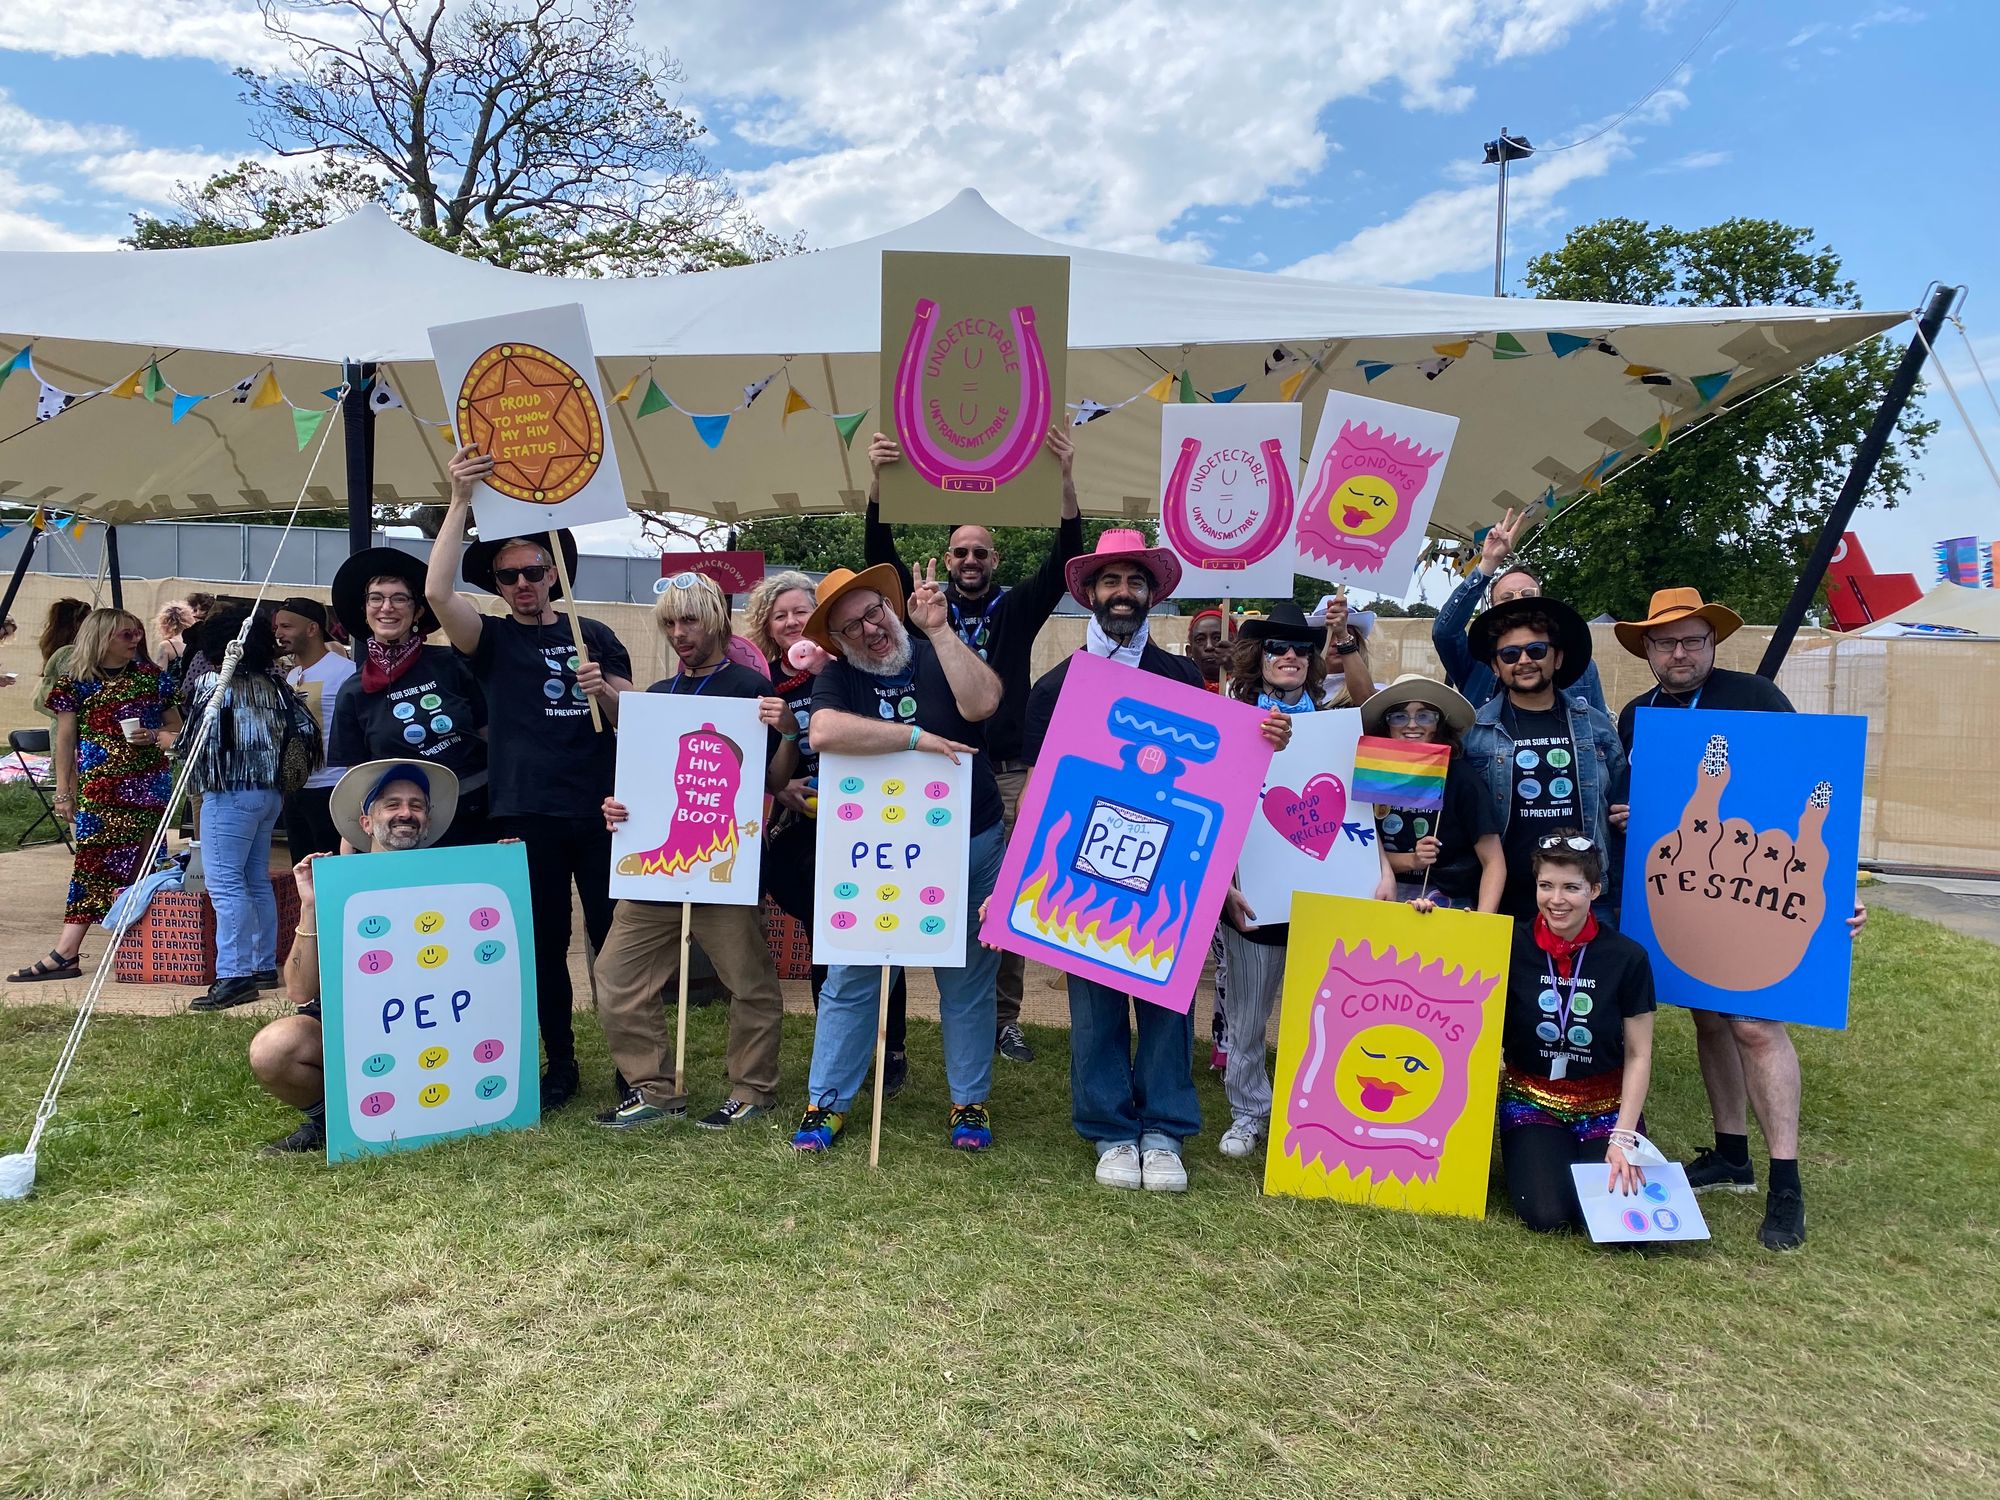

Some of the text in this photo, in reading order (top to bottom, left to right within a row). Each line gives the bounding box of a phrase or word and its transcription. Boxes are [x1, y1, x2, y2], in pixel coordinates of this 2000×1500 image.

[926, 318, 1020, 378] UNDETECTABLE
[499, 393, 541, 411] PROUD
[492, 410, 550, 428] TO KNOW
[929, 399, 1009, 449] UNTRANSMITTABLE
[500, 425, 550, 442] MY HIV
[503, 441, 557, 459] STATUS
[1190, 449, 1268, 492] UNDETECTABLE
[1341, 454, 1415, 490] CONDOMS
[954, 480, 962, 490] U
[979, 481, 988, 491] U
[1192, 506, 1259, 540] UNTRANSMITTABLE
[690, 559, 746, 587] SMACKDOWN
[386, 680, 437, 701] OUR SURE WAYS
[545, 708, 554, 716] TO
[554, 708, 581, 717] PREVENT
[788, 699, 803, 710] FOUR
[451, 735, 462, 744] HIV
[688, 738, 723, 754] GIVE
[1514, 737, 1570, 747] FOUR SURE WAYS
[689, 756, 721, 772] HIV
[676, 773, 728, 788] STIGMA
[685, 790, 722, 808] THE
[1285, 795, 1320, 816] PROUD
[677, 808, 729, 824] BOOT
[1298, 809, 1320, 826] 2 B
[1520, 807, 1573, 817] TO PREVENT HIV
[1107, 816, 1124, 829] NO
[1289, 821, 1337, 845] PRICKED
[851, 841, 921, 869] PEP
[1084, 822, 1156, 873] PrEP
[165, 896, 205, 908] BRIXTON
[152, 908, 168, 917] GET
[170, 909, 176, 918] A
[152, 918, 164, 927] OF
[165, 919, 206, 929] BRIXTON
[152, 930, 168, 939] GET
[170, 931, 177, 940] A
[152, 940, 207, 951] OF BRIXTON
[116, 951, 143, 960] TASTE
[152, 952, 169, 961] GET
[171, 953, 178, 962] A
[152, 962, 207, 972] OF BRIXTON
[116, 972, 144, 982] TASTE
[152, 974, 169, 983] GET
[171, 975, 178, 984] A
[1576, 977, 1596, 989] WAYS
[382, 989, 471, 1034] PEP
[1341, 993, 1465, 1042] CONDOMS
[1539, 1049, 1549, 1058] TO
[1580, 1055, 1593, 1064] HIV
